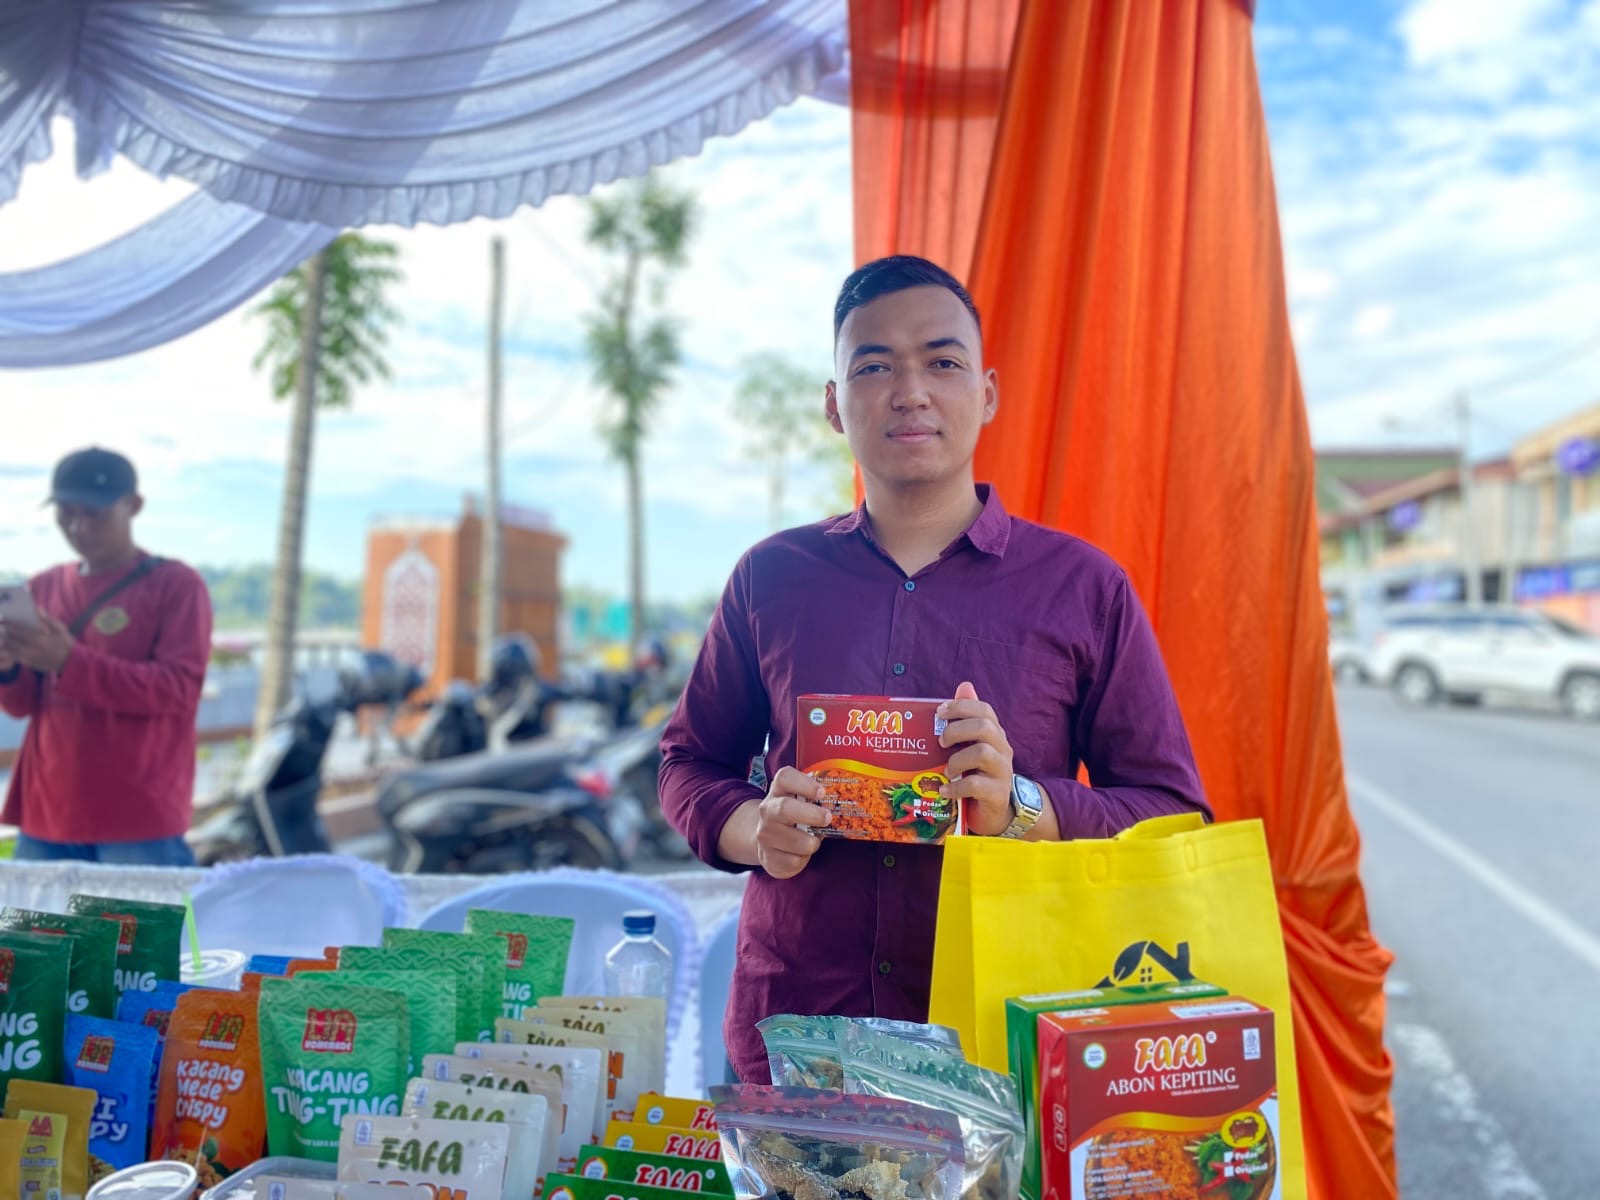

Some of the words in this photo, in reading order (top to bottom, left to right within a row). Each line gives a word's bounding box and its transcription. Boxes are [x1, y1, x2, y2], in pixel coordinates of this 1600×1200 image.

[825, 734, 861, 746] ABON
[866, 736, 926, 750] KEPITING
[286, 1067, 369, 1094] KACANG
[1106, 1076, 1155, 1097] ABON
[1161, 1067, 1236, 1091] KEPITING
